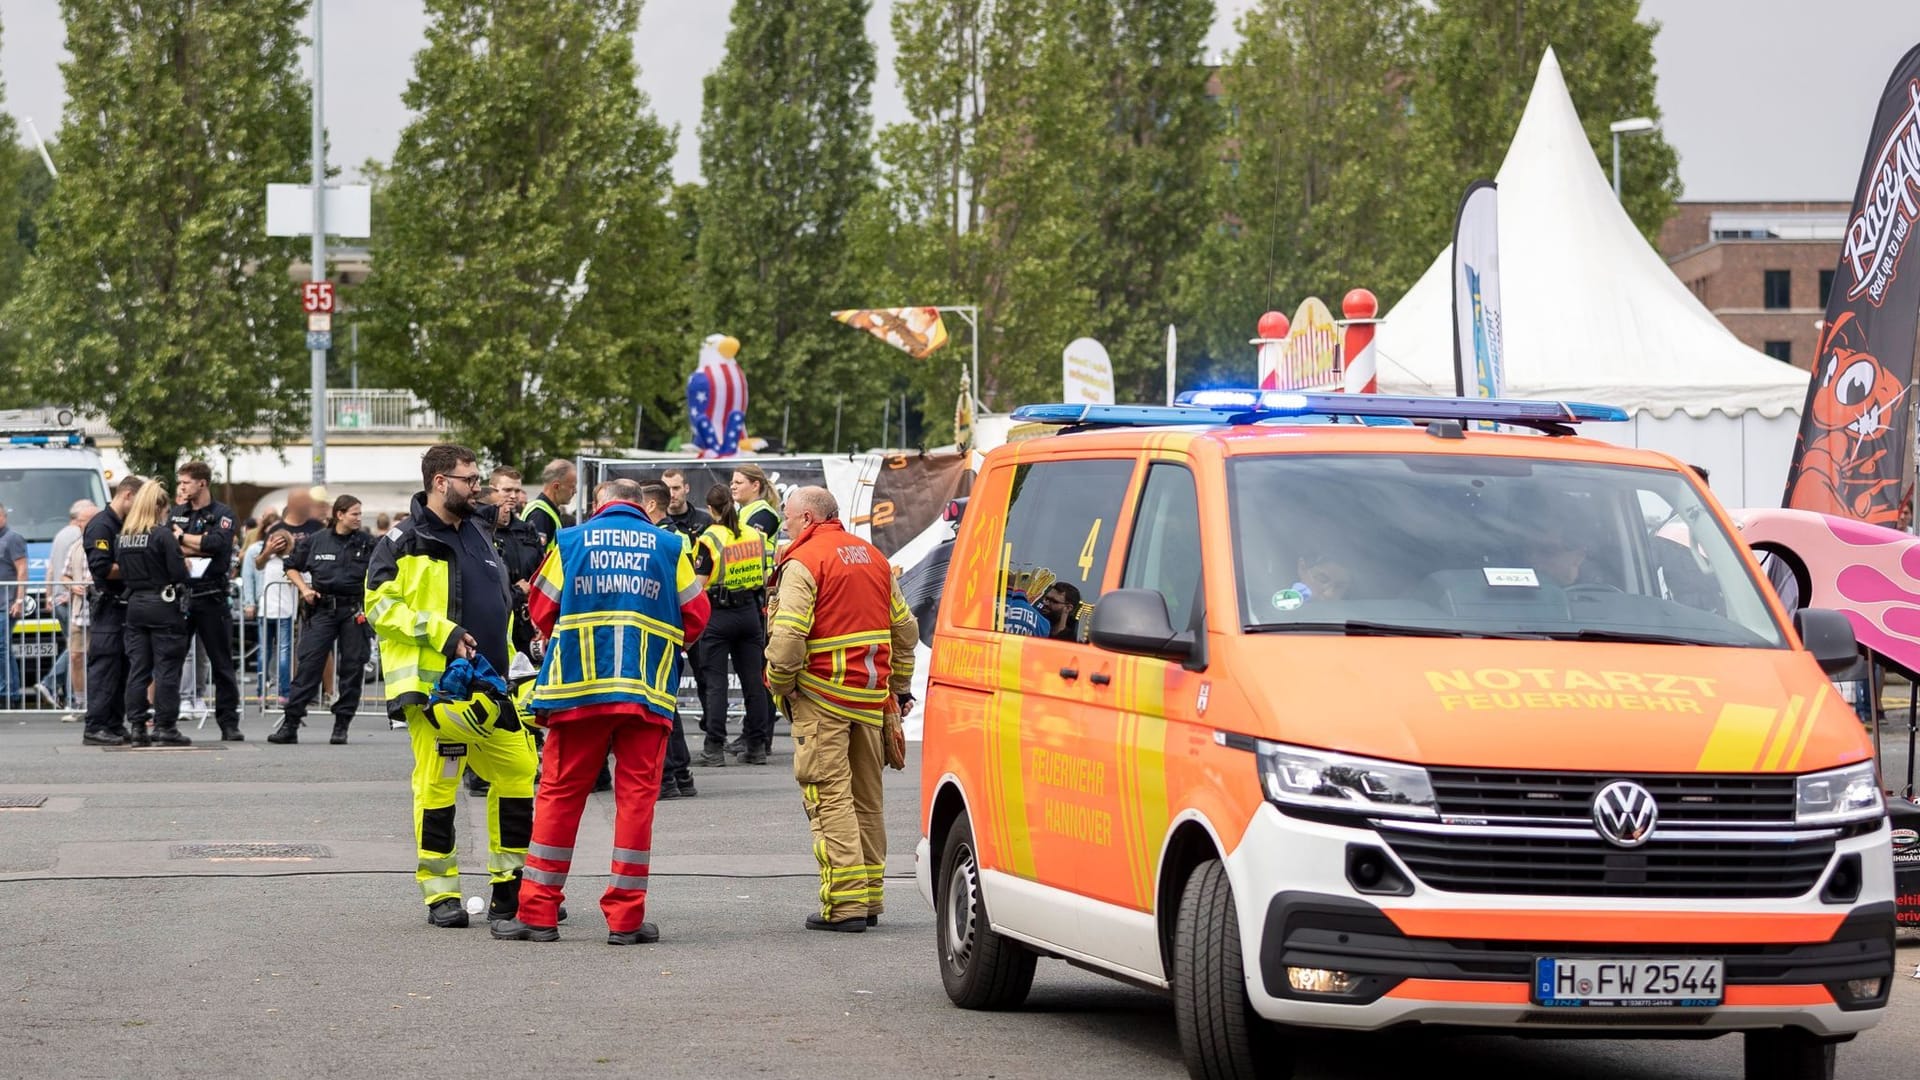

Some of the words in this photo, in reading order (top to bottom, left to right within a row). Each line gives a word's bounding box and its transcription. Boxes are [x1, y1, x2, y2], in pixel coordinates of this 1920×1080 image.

[1892, 215, 1909, 239] hell
[1888, 239, 1899, 256] to
[1881, 256, 1893, 276] ya
[304, 284, 332, 311] 55
[1869, 269, 1887, 300] Rod
[872, 500, 895, 527] 2
[118, 533, 149, 548] POLIZEI
[584, 529, 657, 550] LEITENDER
[1078, 518, 1102, 582] 4
[590, 550, 650, 572] NOTARZT
[575, 575, 593, 596] FW
[596, 574, 661, 600] HANNOVER
[936, 640, 983, 679] NOTARZT
[1424, 668, 1718, 697] NOTARZT
[1440, 692, 1704, 714] FEUERWEHR
[1032, 748, 1105, 797] FEUERWEHR
[1045, 799, 1111, 848] HANNOVER
[1557, 965, 1576, 994] H
[1597, 965, 1636, 994] FW
[1643, 965, 1717, 994] 2544
